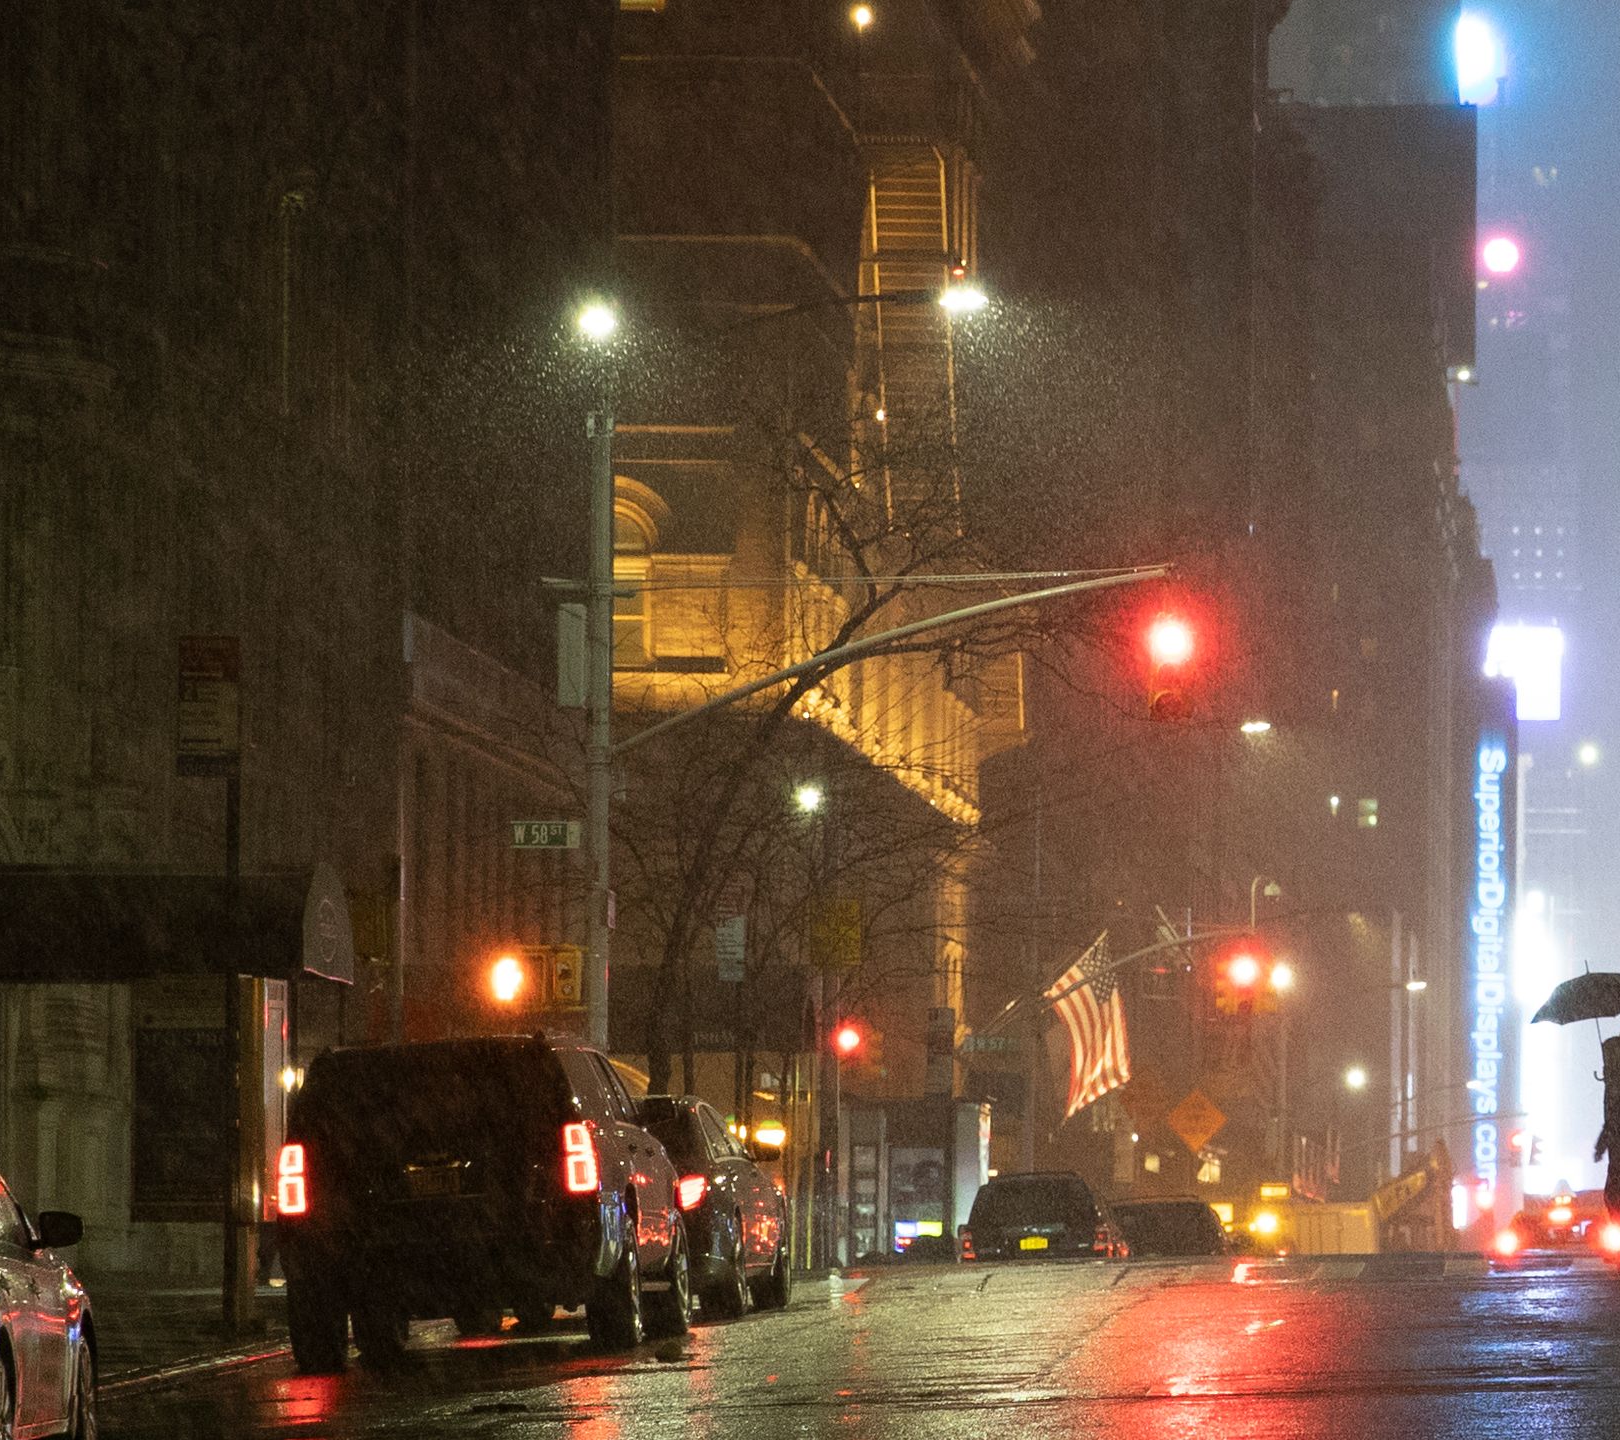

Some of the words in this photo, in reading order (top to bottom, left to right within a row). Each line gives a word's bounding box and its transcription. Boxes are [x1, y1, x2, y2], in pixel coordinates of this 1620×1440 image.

[514, 824, 526, 844] W
[531, 824, 549, 845] 58
[550, 825, 562, 836] ST
